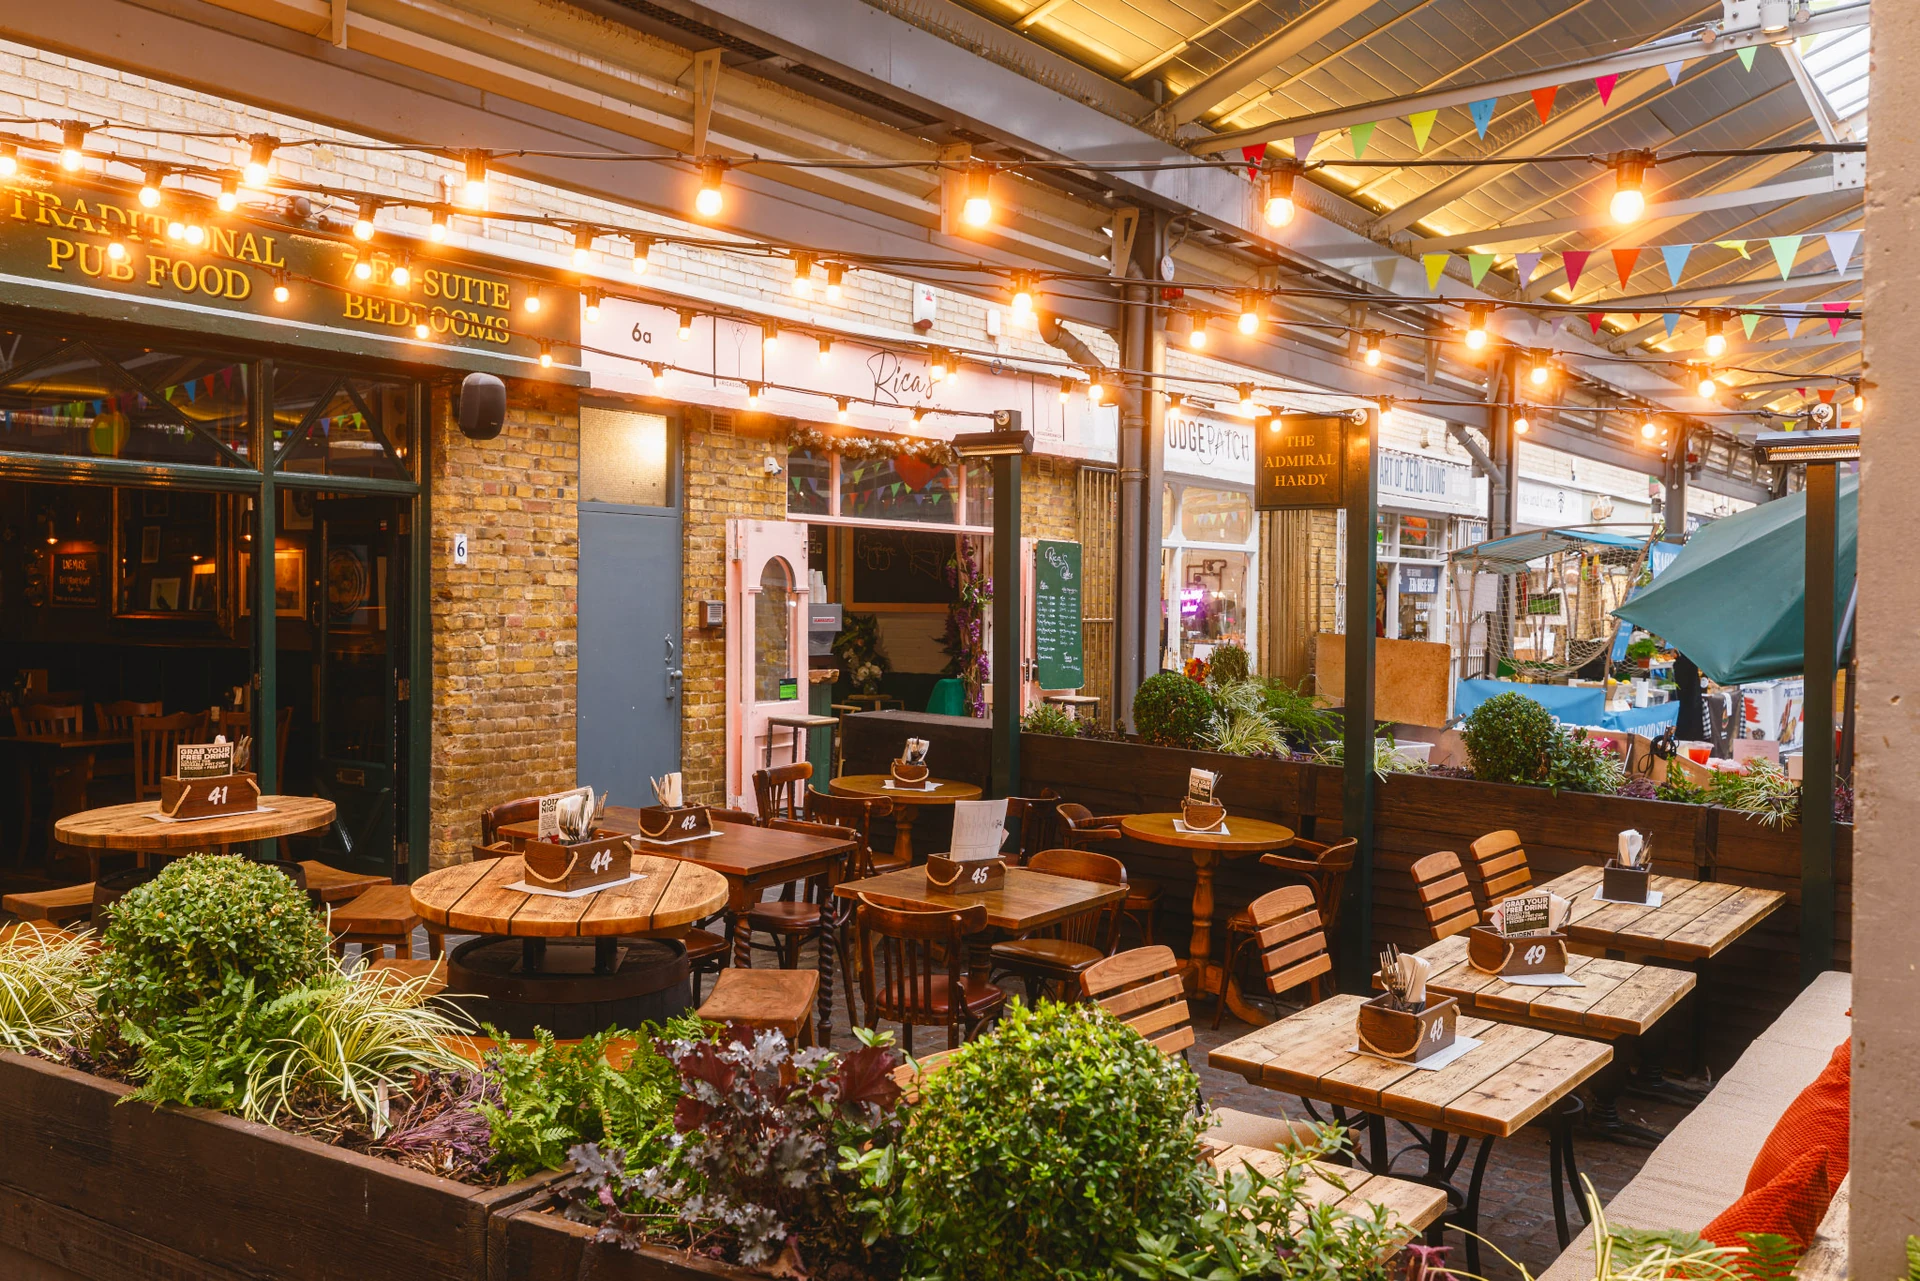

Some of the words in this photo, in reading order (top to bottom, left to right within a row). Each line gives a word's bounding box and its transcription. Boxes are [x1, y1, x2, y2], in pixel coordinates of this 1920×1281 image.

[3, 185, 285, 269] TRADITNAL
[47, 236, 136, 282] PUB
[146, 254, 251, 300] FOOD
[342, 252, 359, 281] 7
[632, 322, 652, 344] 6a
[866, 349, 941, 407] Rica's
[1284, 434, 1316, 448] THE
[1264, 453, 1337, 469] ADMIRAL
[1274, 473, 1329, 488] HARDY
[1379, 455, 1393, 487] ART
[1394, 458, 1404, 488] OF
[1425, 464, 1446, 495] LIVING
[456, 540, 466, 558] 6
[204, 752, 230, 761] DRINK
[207, 746, 230, 754] YOUR
[207, 785, 229, 805] 41
[681, 814, 697, 831] 42
[590, 848, 613, 875] 44
[971, 866, 990, 884] 45
[1506, 899, 1525, 907] GRAB
[1506, 930, 1536, 938] STUDENT
[1523, 944, 1547, 965] 49
[1429, 1016, 1444, 1042] 48
